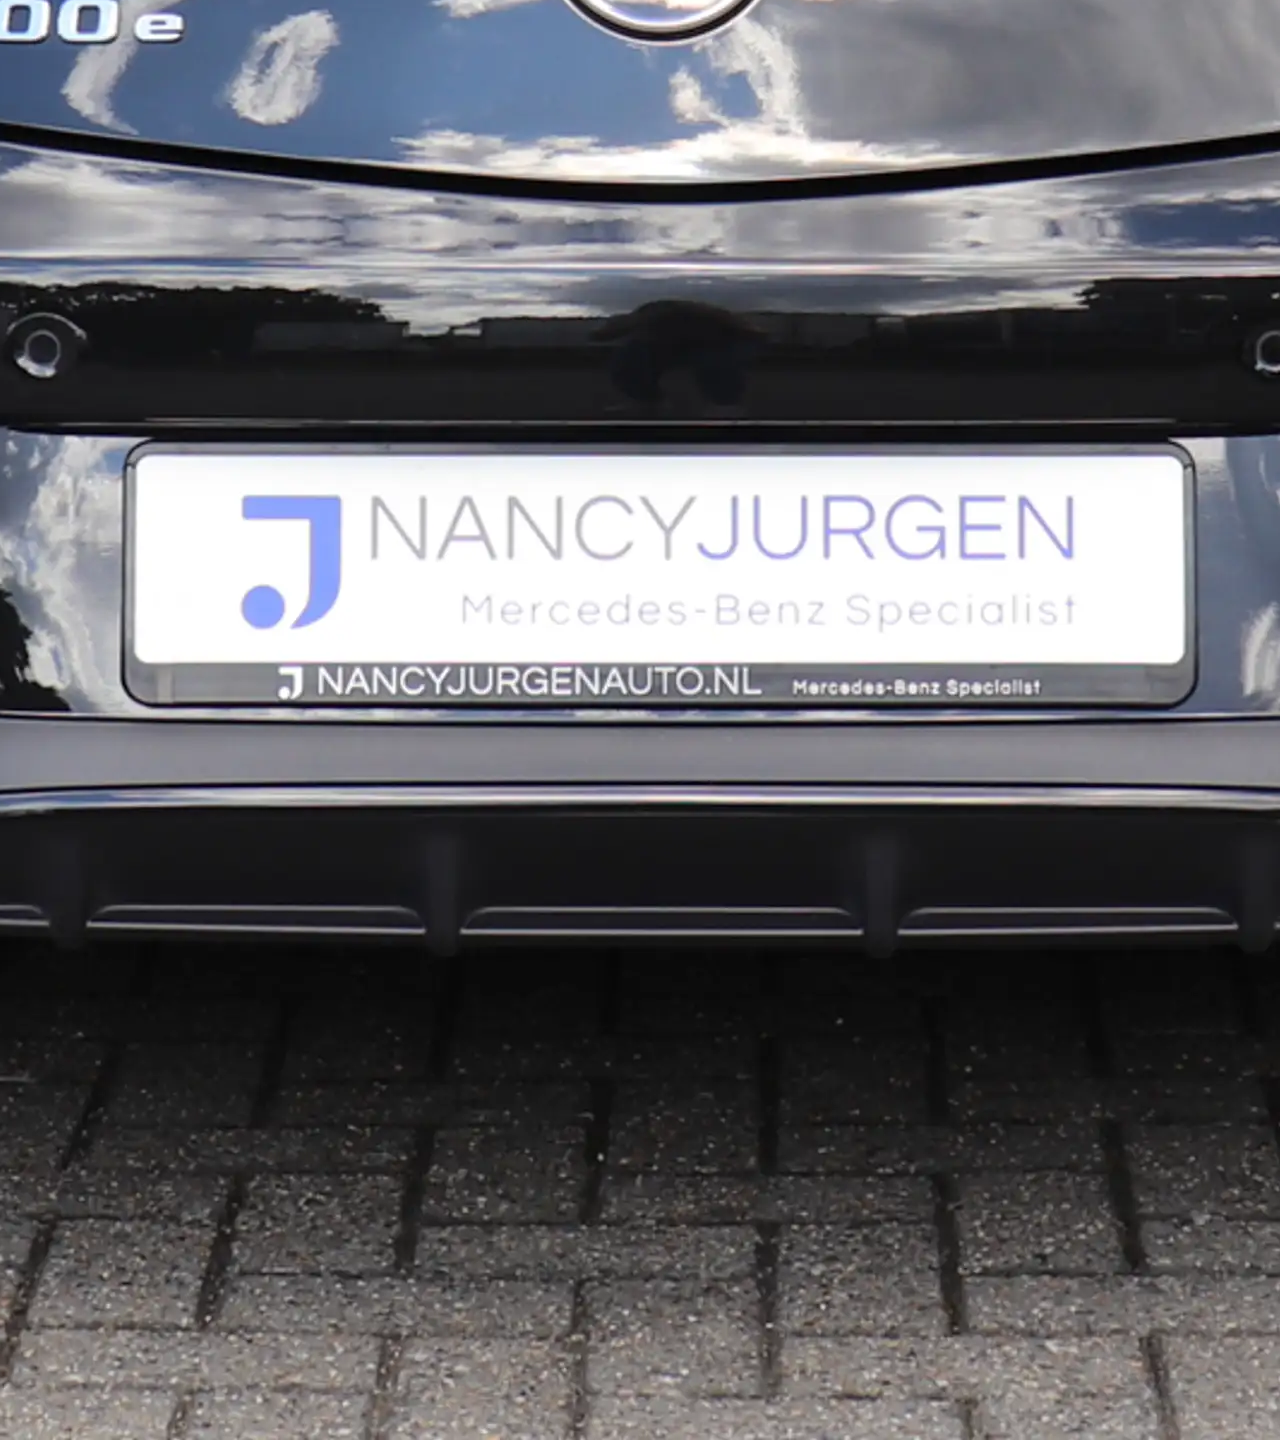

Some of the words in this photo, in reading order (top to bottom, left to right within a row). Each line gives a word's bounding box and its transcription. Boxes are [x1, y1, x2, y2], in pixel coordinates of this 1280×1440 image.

[371, 495, 1074, 561] NANCYJURGEN
[462, 593, 826, 626] Mercedes-Benz
[846, 593, 1078, 632] Specialist
[318, 666, 763, 696] NANCYJURGENAUTO.NL
[793, 678, 941, 696] Mercedes-Benz
[946, 678, 1041, 698] Specialist
